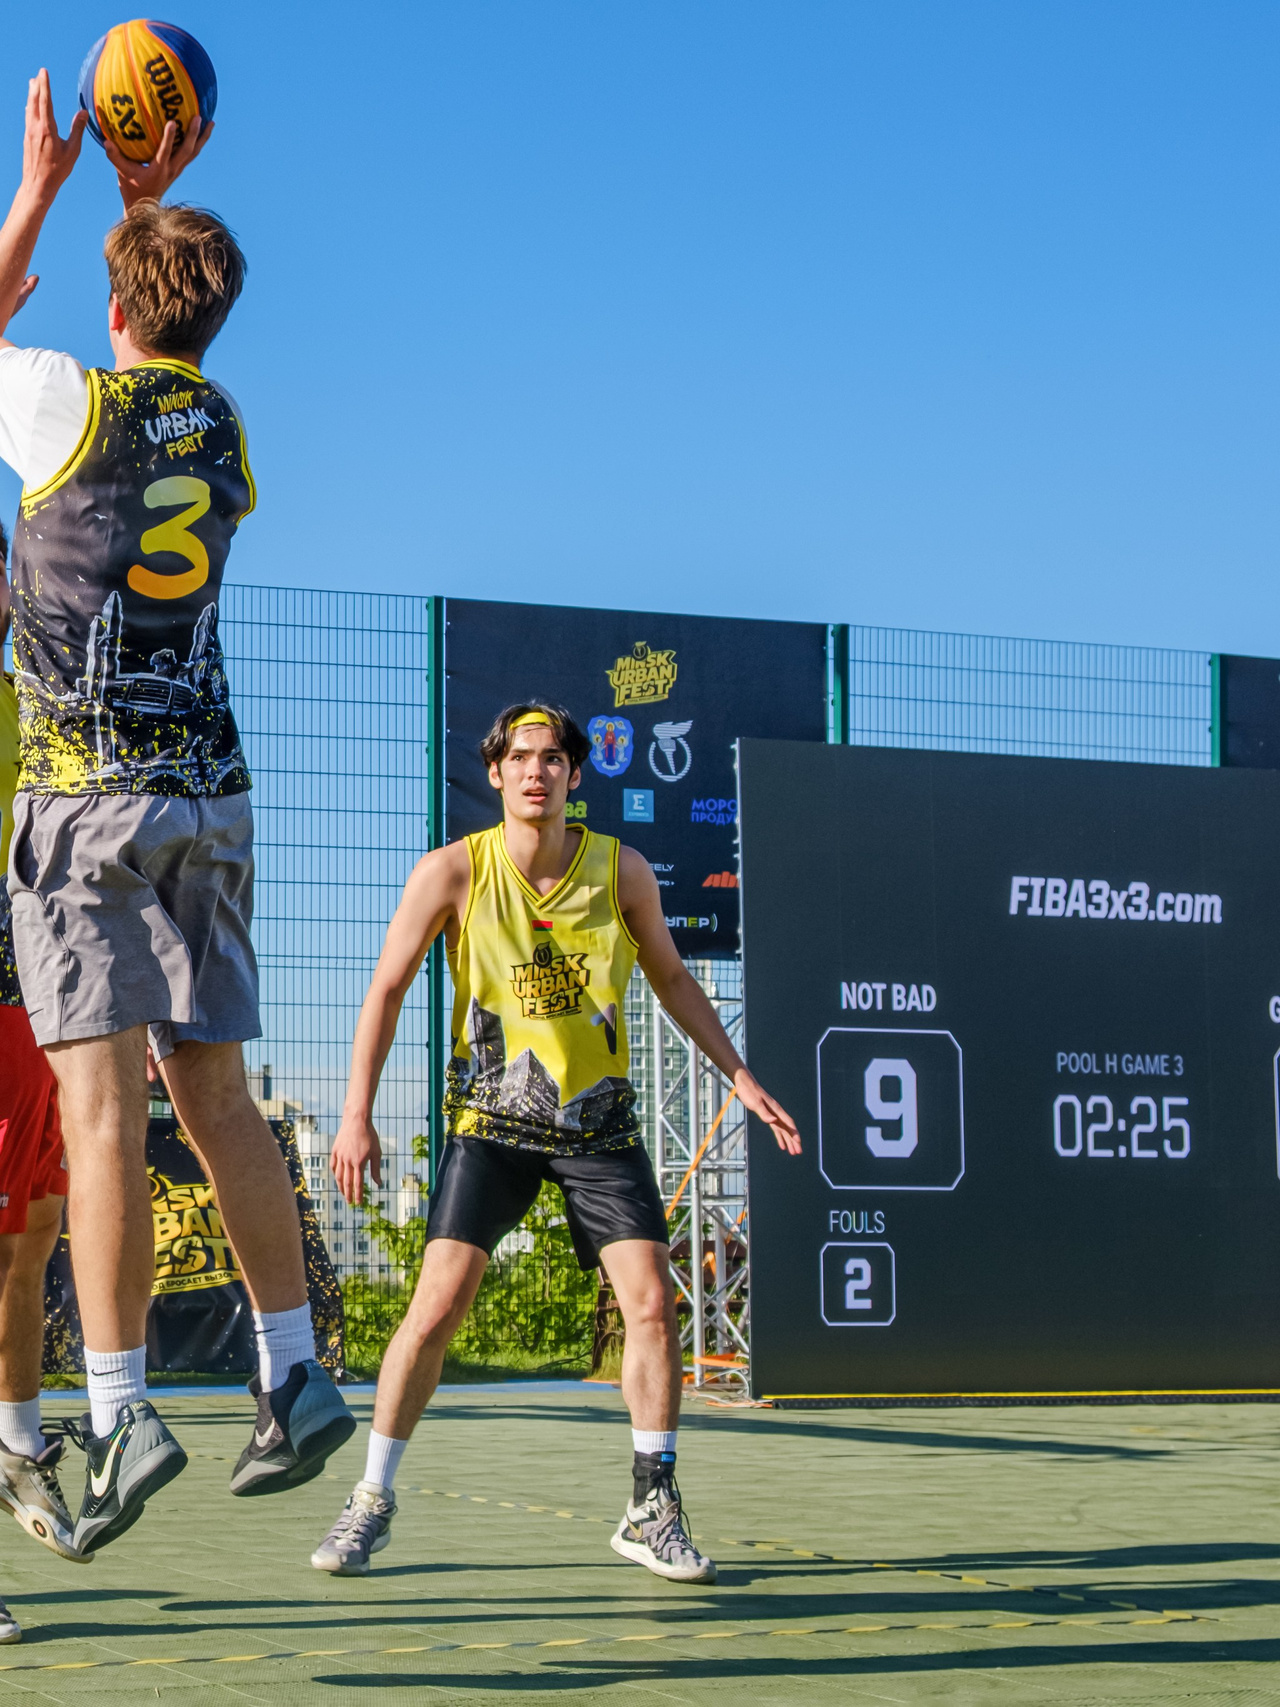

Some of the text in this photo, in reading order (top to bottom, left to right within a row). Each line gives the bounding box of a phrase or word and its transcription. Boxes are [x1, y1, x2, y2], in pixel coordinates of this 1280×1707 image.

[145, 407, 216, 444] URBAN
[166, 431, 205, 460] FEST
[126, 475, 211, 600] 3
[612, 664, 673, 686] URBAN
[616, 652, 670, 671] MINSK
[619, 679, 668, 703] FEST
[691, 798, 737, 812] МОРО
[691, 812, 735, 826] ПРОДУ
[1009, 876, 1223, 924] FIBA3x3.com
[665, 915, 710, 928] УПЕР
[514, 954, 584, 982] MINSK
[513, 969, 588, 998] URBAN
[841, 981, 937, 1012] NOT BAD
[522, 987, 580, 1016] FEST
[1056, 1052, 1184, 1076] POOL H GAME 3
[863, 1058, 919, 1159] 9
[1053, 1094, 1190, 1158] 02:25
[829, 1210, 885, 1234] FOULS
[154, 1236, 230, 1280] EST
[844, 1258, 872, 1310] 2
